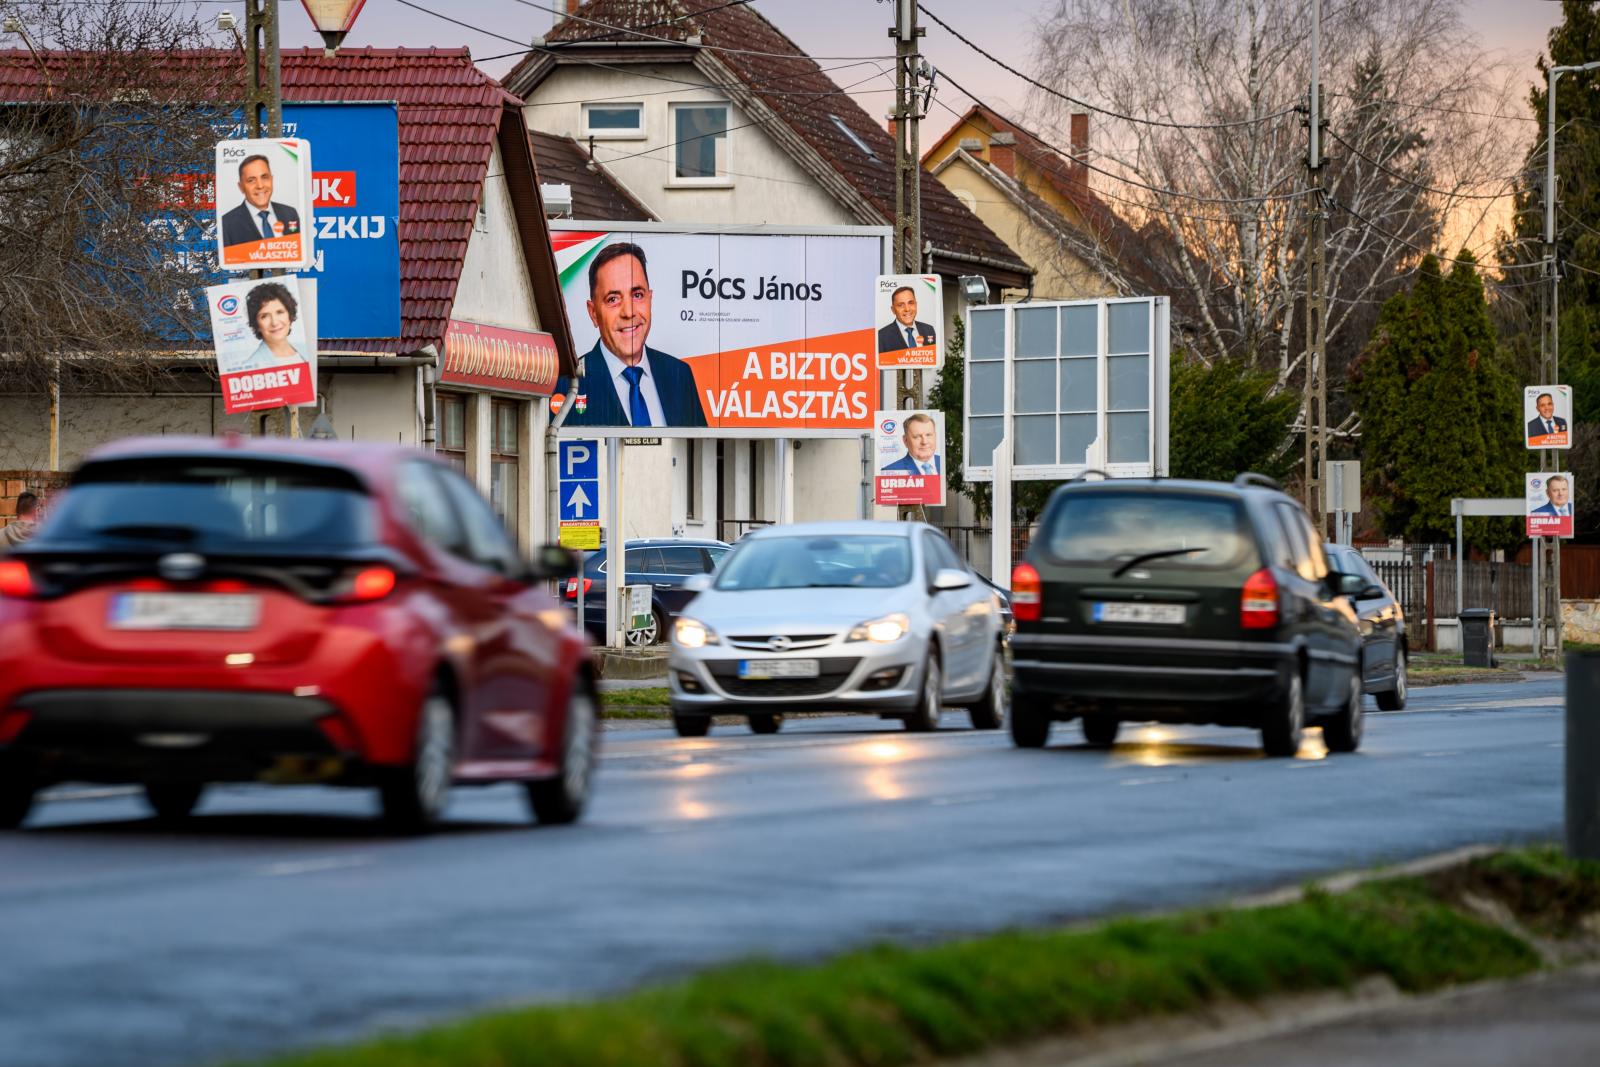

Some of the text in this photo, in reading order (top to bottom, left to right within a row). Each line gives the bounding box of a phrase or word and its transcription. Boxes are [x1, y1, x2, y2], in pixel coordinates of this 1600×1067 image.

[223, 147, 246, 157] Pócs
[259, 240, 298, 250] A BIZTOS
[248, 249, 299, 260] VÁLASZTÁS
[681, 268, 822, 301] Pócs János
[880, 280, 898, 288] Pócs
[679, 309, 697, 322] 02.
[911, 349, 934, 357] BIZTOS
[742, 351, 868, 381] A BIZTOS
[227, 368, 301, 394] DOBREV
[705, 381, 868, 419] VÁLASZTÁS
[624, 437, 659, 445] NESS CLUB
[566, 445, 590, 475] P
[880, 476, 925, 488] URBÁN
